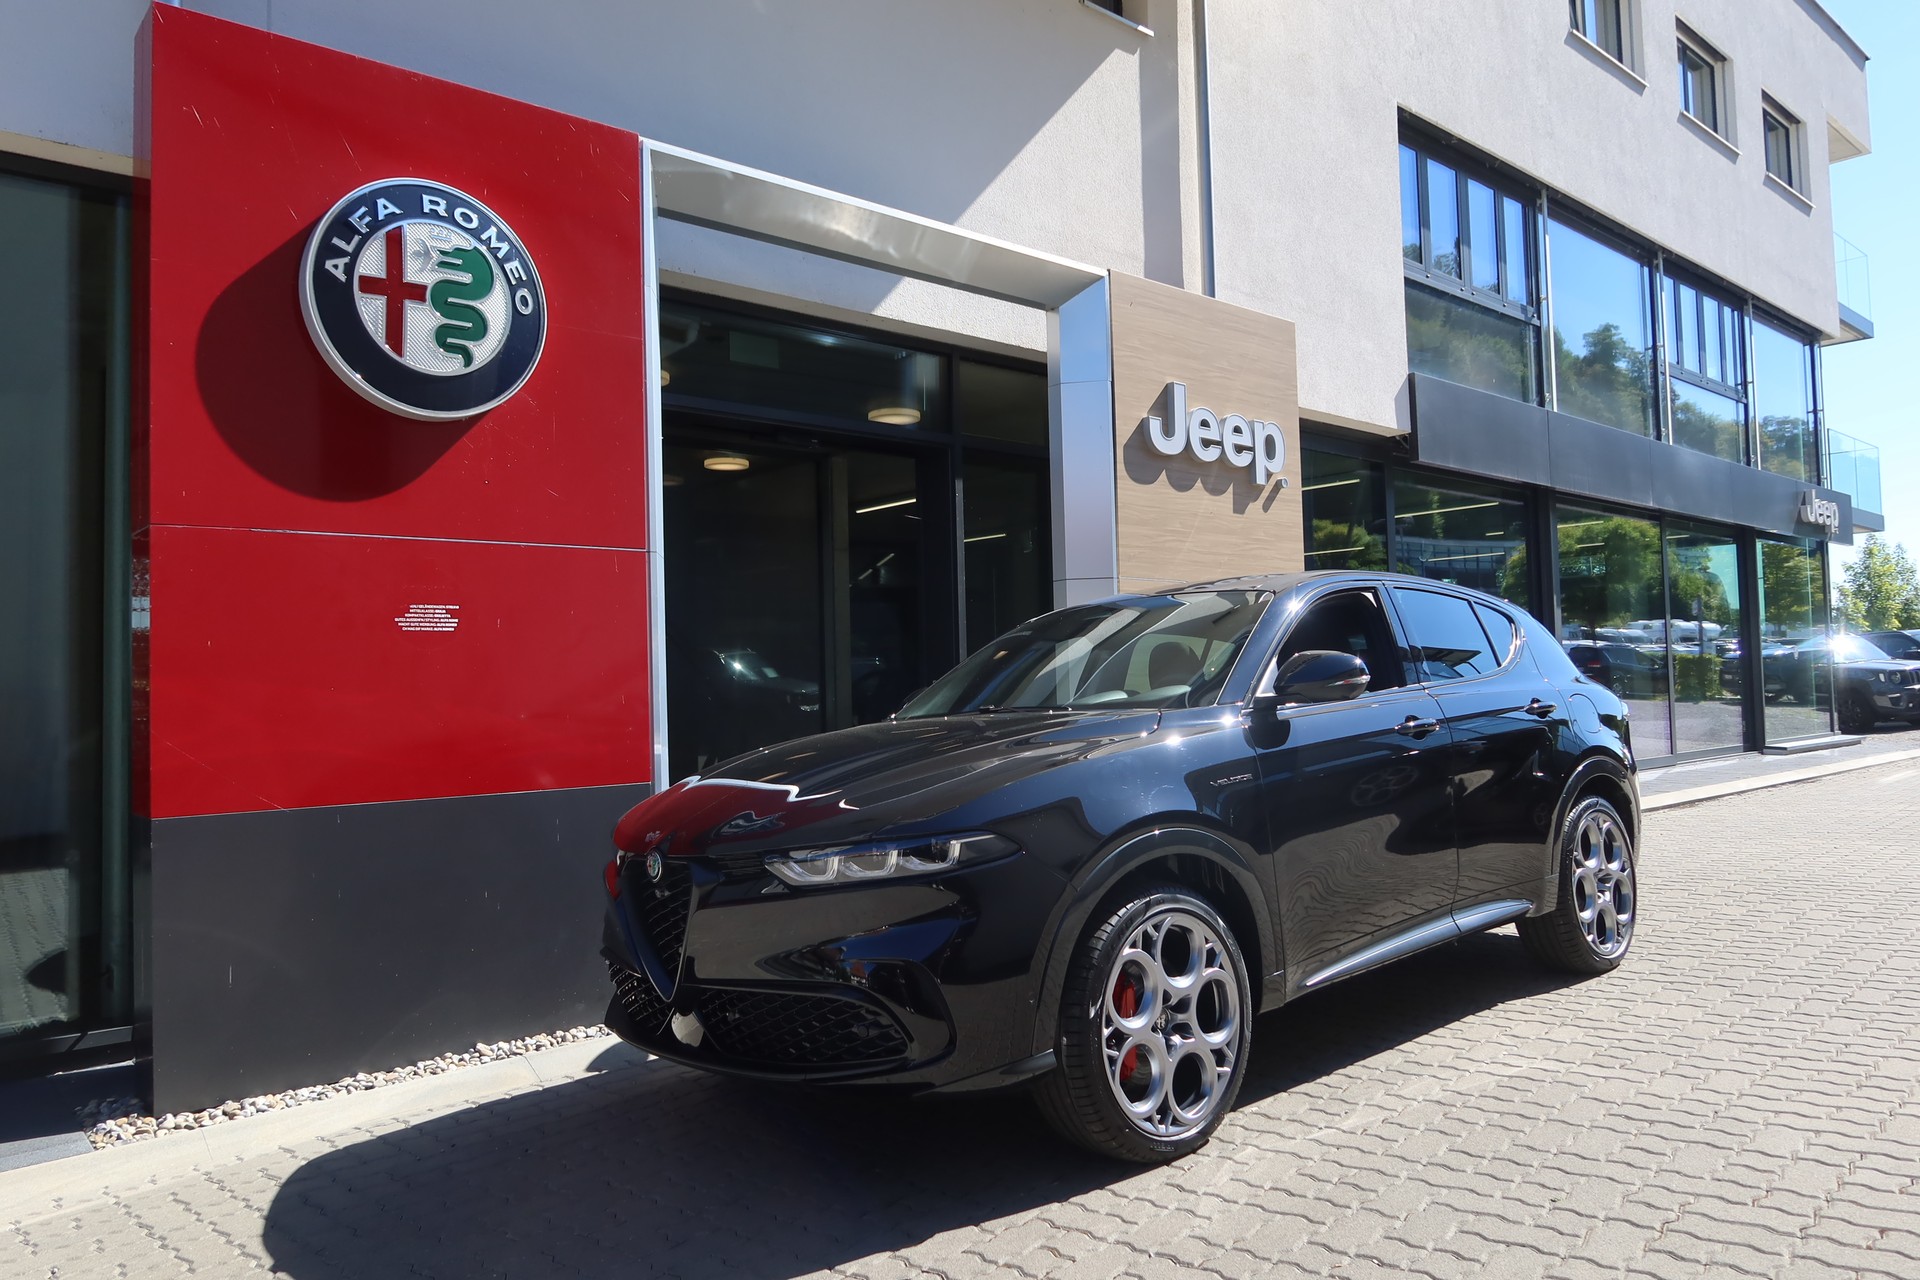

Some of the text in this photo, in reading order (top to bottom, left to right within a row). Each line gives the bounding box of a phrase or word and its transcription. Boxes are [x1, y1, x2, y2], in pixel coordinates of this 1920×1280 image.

[324, 193, 533, 315] ALFA ROMEO
[1144, 381, 1286, 486] Jeep
[1801, 488, 1839, 533] Jeep
